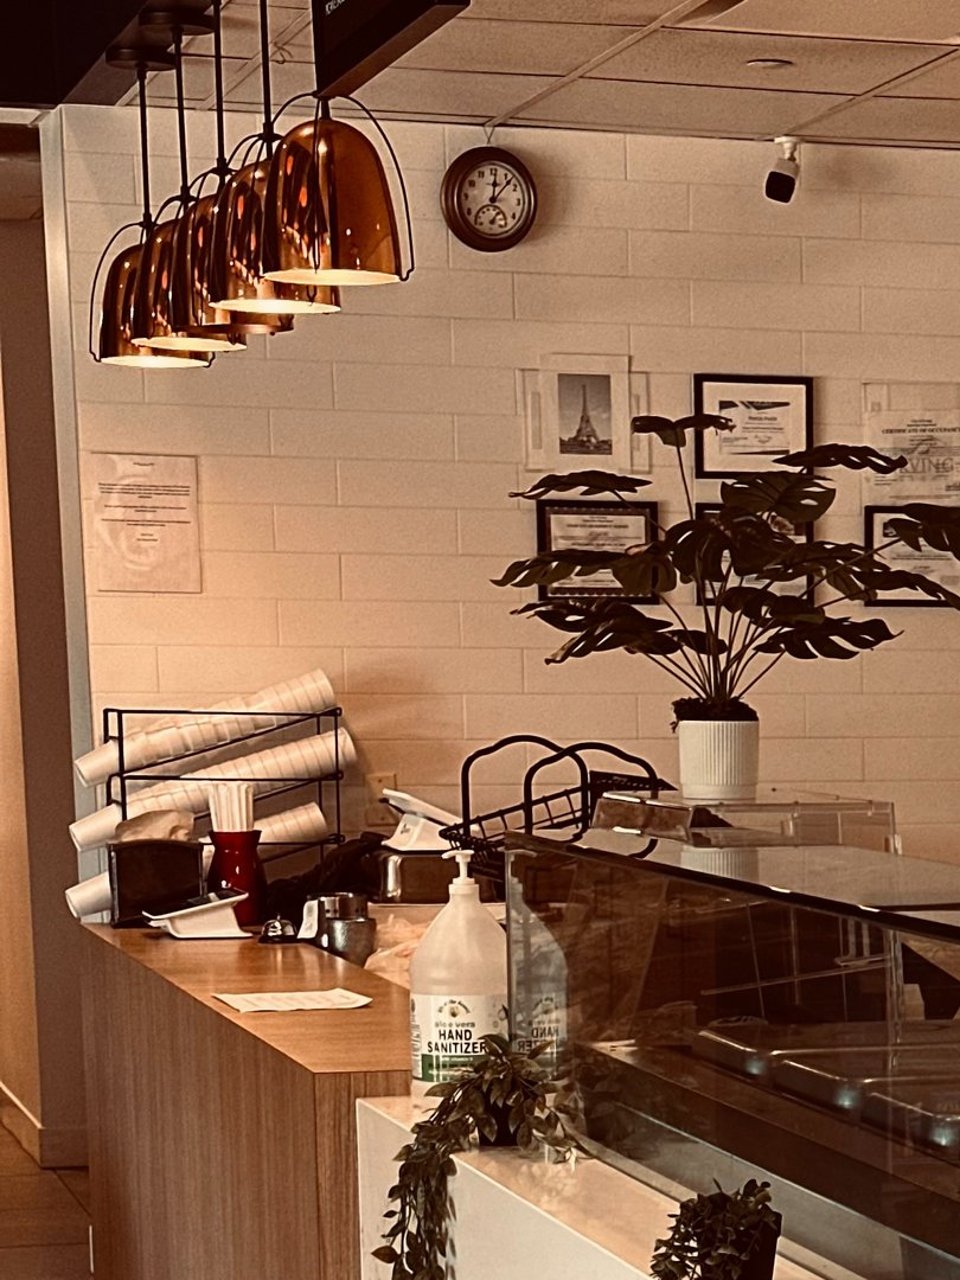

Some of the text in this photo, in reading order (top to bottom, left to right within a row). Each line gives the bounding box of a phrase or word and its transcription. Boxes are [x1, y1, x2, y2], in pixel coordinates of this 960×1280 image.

[490, 168, 498, 176] 12
[513, 183, 517, 192] 2
[438, 1029, 472, 1041] HAND
[427, 1041, 486, 1053] SANITIZER
